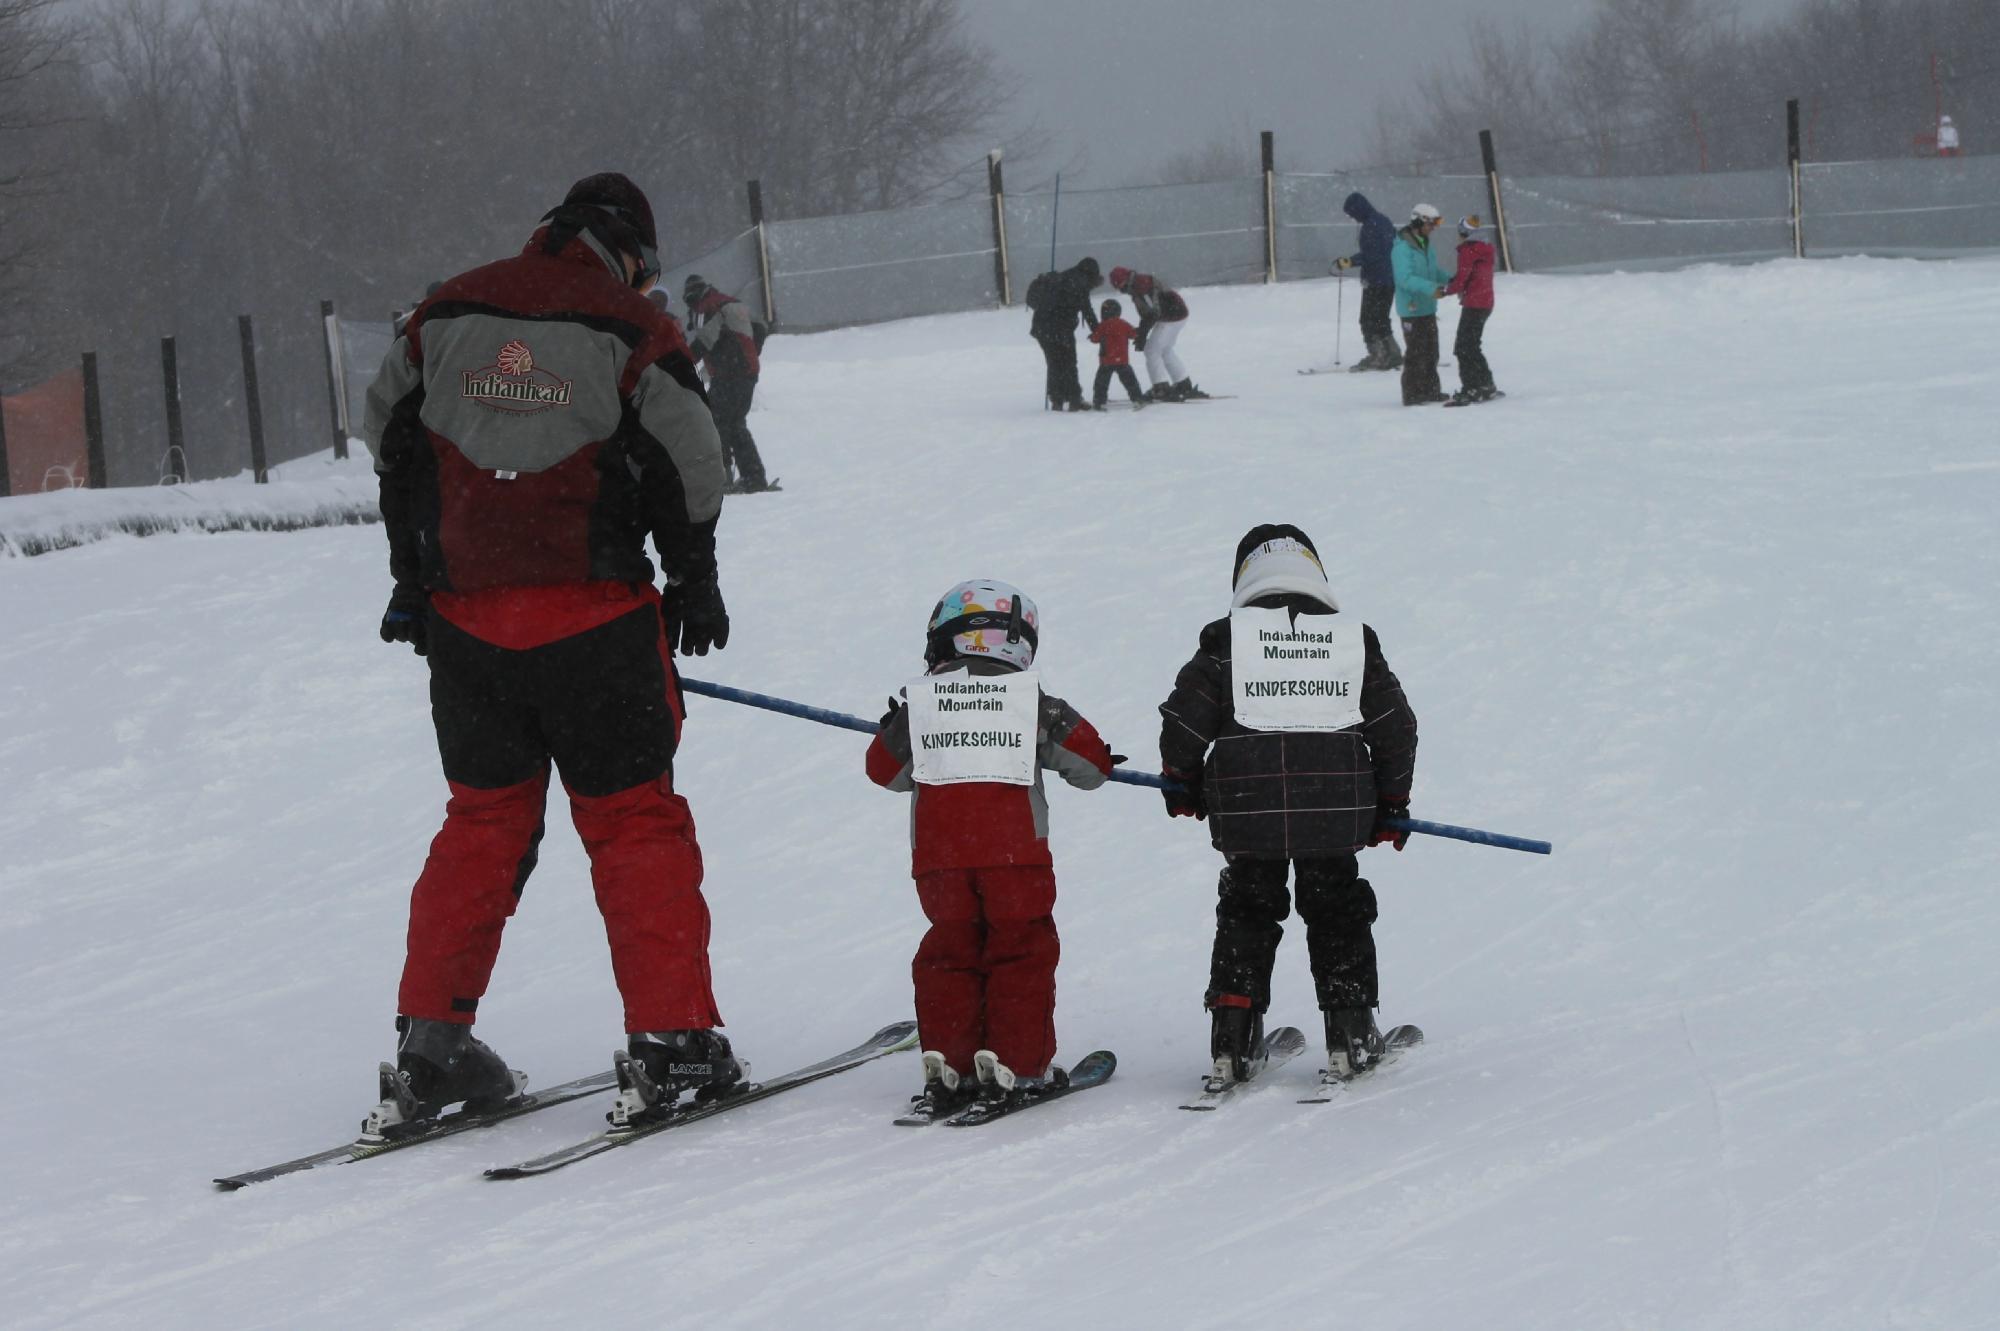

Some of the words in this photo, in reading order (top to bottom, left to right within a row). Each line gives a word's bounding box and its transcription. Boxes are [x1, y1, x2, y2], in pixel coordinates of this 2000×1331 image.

[462, 371, 572, 404] Indianhead
[1259, 629, 1333, 643] Indianhead
[1264, 646, 1330, 659] Mountain
[934, 681, 1007, 694] Indianhead
[1245, 680, 1349, 697] KINDERSCHULE
[938, 698, 1003, 712] Mountain
[921, 731, 1022, 750] KINDERSCHULE
[669, 1063, 712, 1075] LANGE
